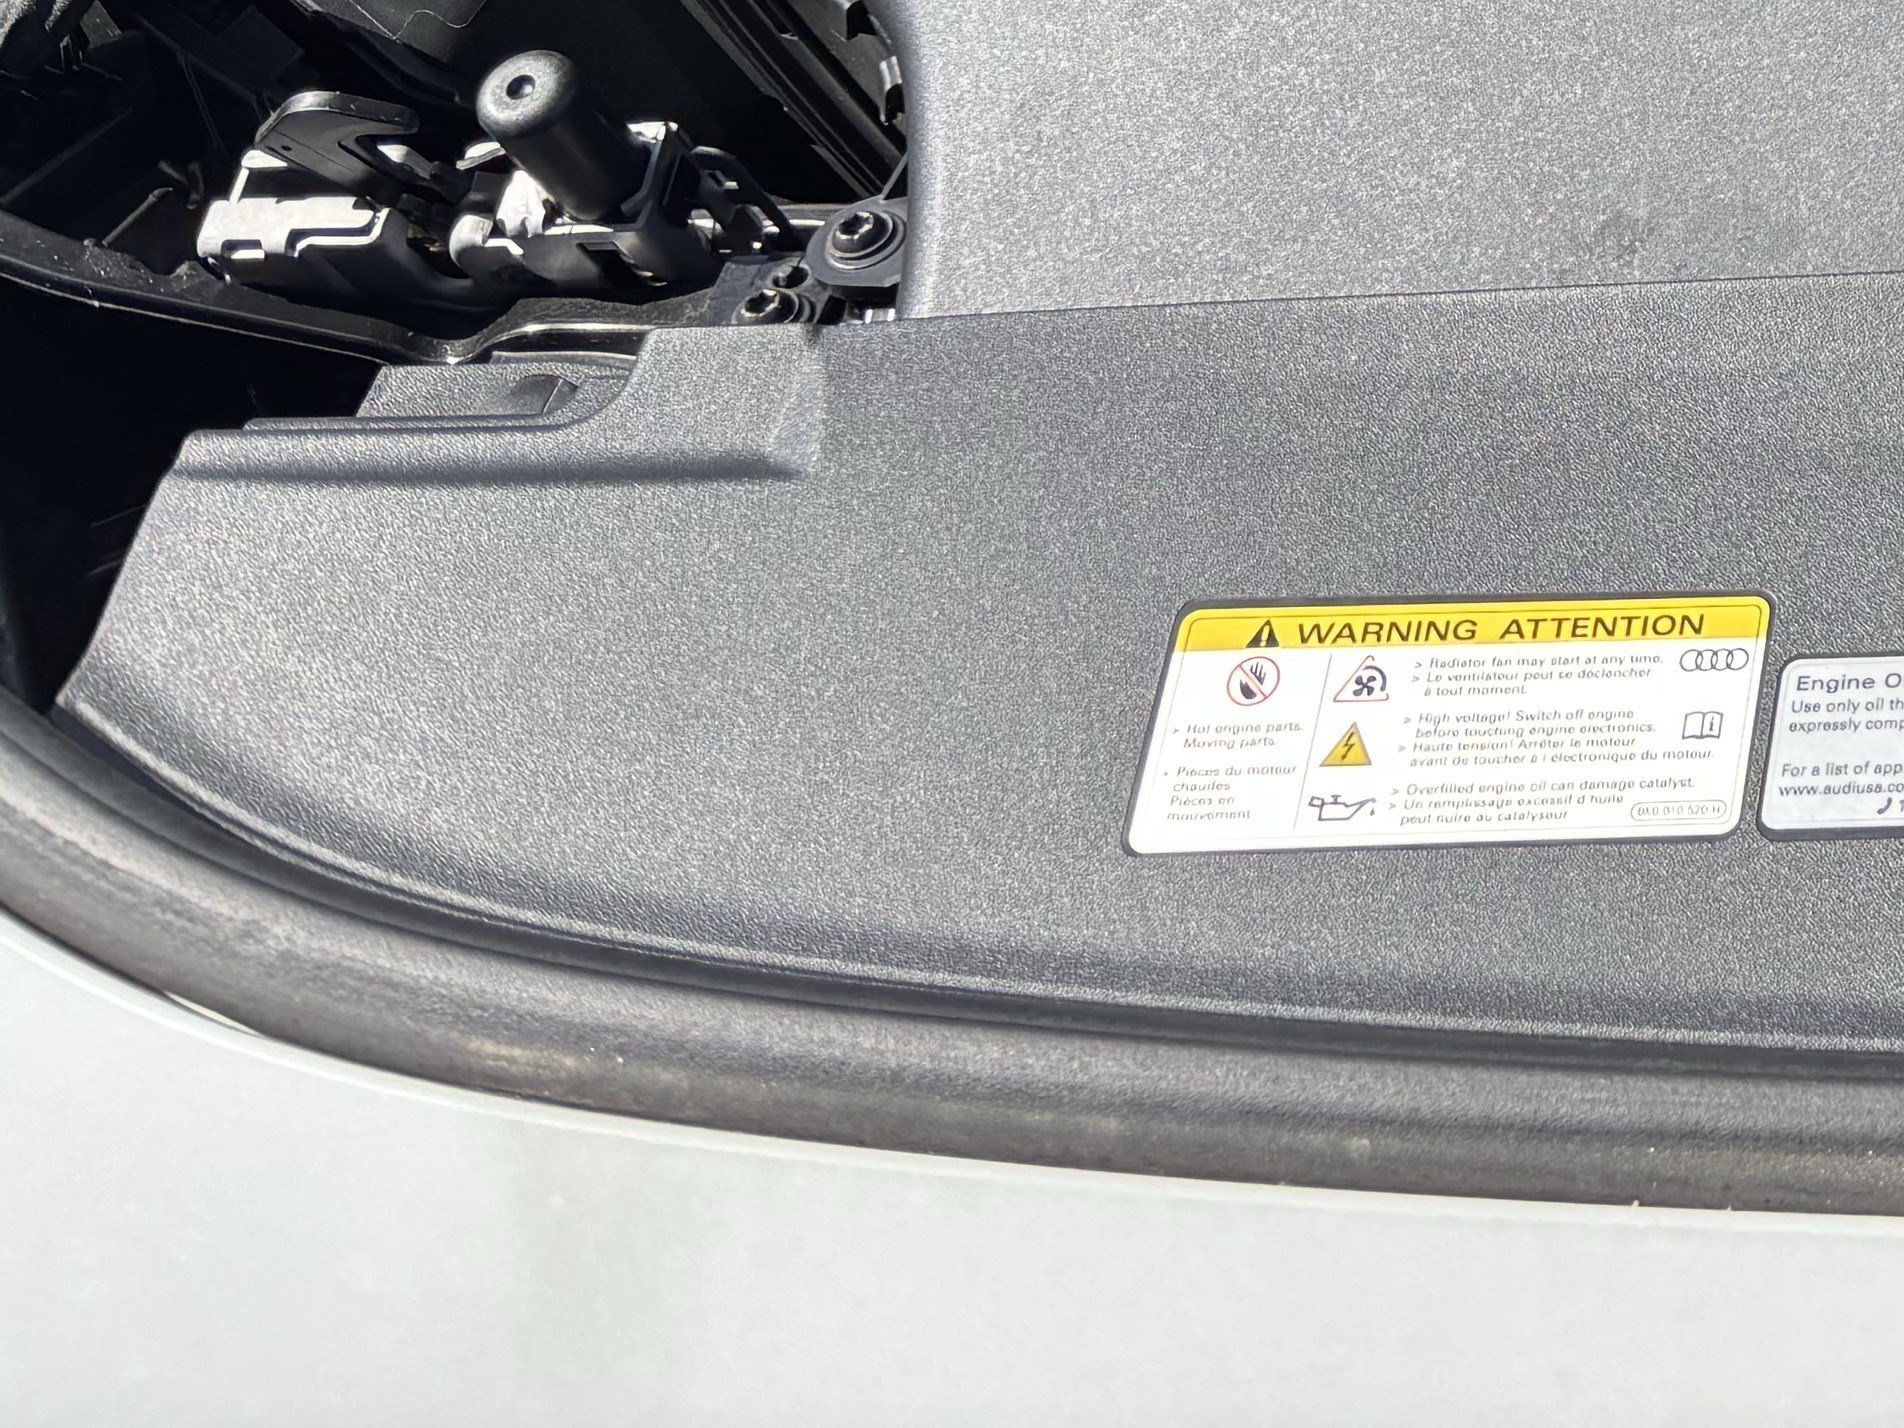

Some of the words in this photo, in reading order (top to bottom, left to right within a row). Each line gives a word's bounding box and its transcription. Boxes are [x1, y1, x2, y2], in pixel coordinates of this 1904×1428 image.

[1298, 619, 1477, 644] WARNING
[1499, 614, 1704, 640] ATTENTION
[1429, 657, 1486, 669] Radiator
[1492, 656, 1512, 667] fan
[1517, 657, 1545, 668] may
[1551, 655, 1579, 666] start
[1585, 655, 1598, 665] at
[1601, 655, 1624, 666] any
[1427, 671, 1442, 682] Le
[1447, 670, 1519, 682] ventilateur
[1436, 686, 1463, 696] tout
[1797, 675, 1875, 693] Engine
[1791, 700, 1821, 713] Use
[1826, 699, 1860, 714] only
[1865, 699, 1884, 711] oil
[1419, 713, 1450, 726] High
[1516, 709, 1561, 722] Switch
[1566, 709, 1585, 719] off
[1588, 710, 1634, 722] engine
[1187, 724, 1210, 734] Hot
[1215, 723, 1261, 734] engine
[1416, 725, 1459, 737] before
[1464, 724, 1524, 737] touching
[1529, 724, 1575, 736] engine
[1789, 717, 1861, 733] expressly
[1183, 738, 1235, 749] Moving
[1413, 741, 1452, 752] Haute
[1570, 737, 1581, 748] le
[1586, 736, 1636, 747] moteur
[1410, 755, 1446, 767] avant
[1453, 754, 1468, 766] de
[1474, 752, 1525, 765] toucher
[1641, 749, 1657, 760] du
[1225, 766, 1241, 776] du
[1247, 765, 1297, 775] moteur
[1782, 763, 1807, 777] For
[1811, 766, 1820, 775] a
[1825, 762, 1848, 775] list
[1854, 761, 1870, 774] of
[1173, 781, 1231, 791] chaudes
[1407, 782, 1473, 796] Overfilled
[1478, 783, 1525, 796] engine
[1530, 780, 1546, 792] oil
[1551, 782, 1574, 791] can
[1579, 780, 1634, 792] damage
[1218, 797, 1234, 805] en
[1404, 799, 1423, 810] Un
[1401, 812, 1431, 826] peut
[1436, 811, 1471, 823] nuire
[1476, 812, 1491, 822] au
